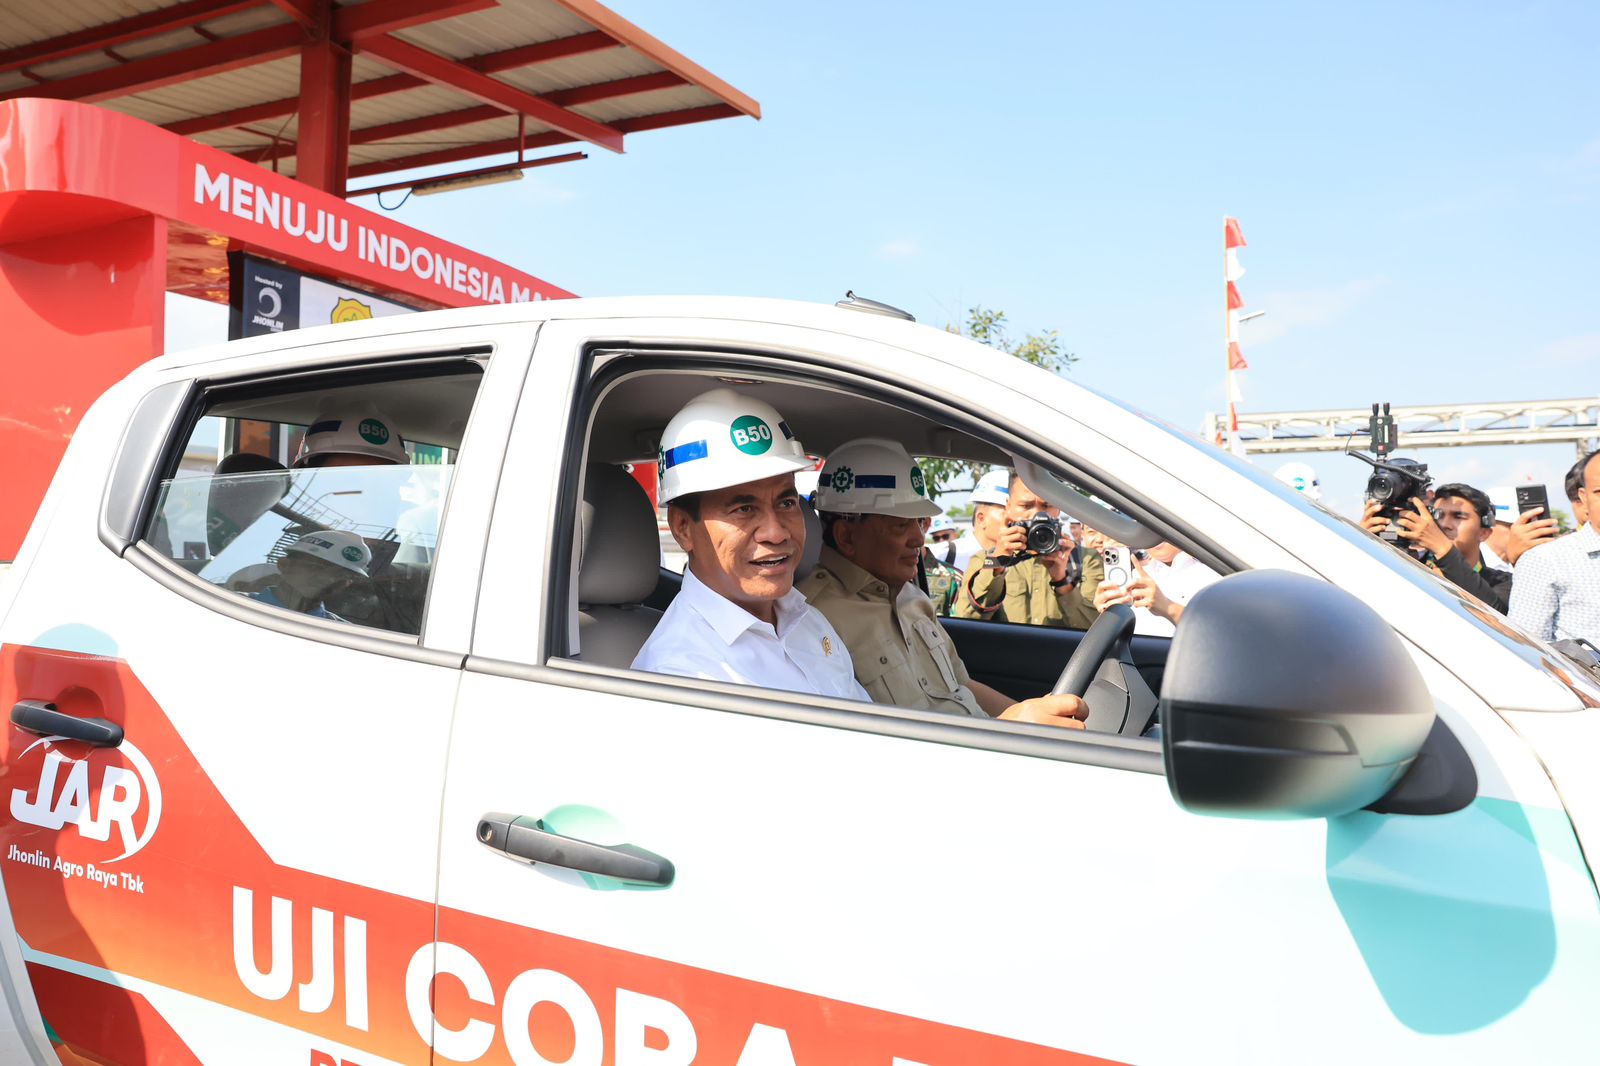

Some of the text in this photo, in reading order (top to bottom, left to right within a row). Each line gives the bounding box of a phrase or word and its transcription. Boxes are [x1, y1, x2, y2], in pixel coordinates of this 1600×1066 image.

[194, 163, 505, 304] MENUJU INDONESIA
[360, 423, 387, 440] B50
[732, 424, 771, 446] B50
[10, 752, 142, 854] JAR
[8, 845, 145, 893] Jhonlin Agro Raya Tbk
[232, 885, 369, 1032] UJI
